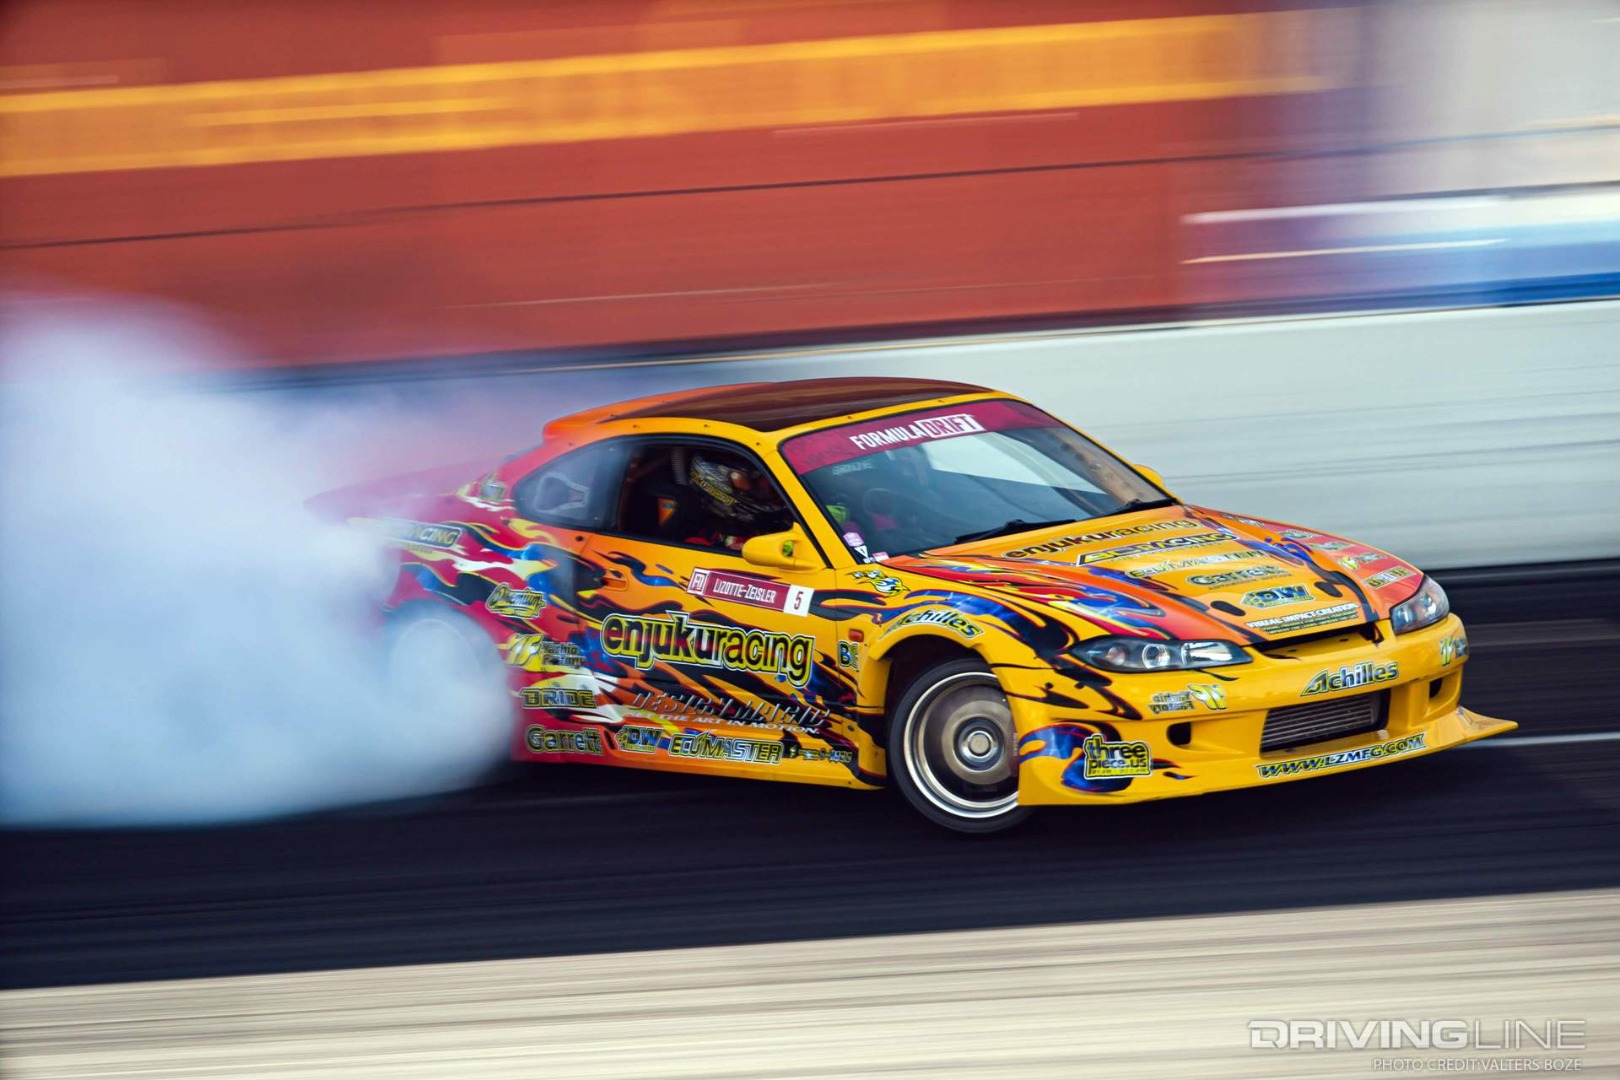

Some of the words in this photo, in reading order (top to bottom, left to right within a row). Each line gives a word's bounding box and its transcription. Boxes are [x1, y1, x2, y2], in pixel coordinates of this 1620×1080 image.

[849, 423, 925, 450] FORMULA
[920, 413, 981, 438] DRIFT
[1004, 519, 1199, 558] enjukuracing
[713, 578, 777, 603] LIZOTTE-ZEISLER
[794, 591, 804, 610] 5
[603, 613, 813, 686] enjukuracing
[1301, 662, 1399, 697] Achilles
[521, 687, 597, 709] BRIDE
[527, 726, 603, 754] Garrett
[669, 732, 784, 764] ECUMASTER
[1088, 736, 1146, 759] three
[1259, 734, 1426, 777] WWW.LZMFG.COM
[1089, 758, 1147, 775] piece.us
